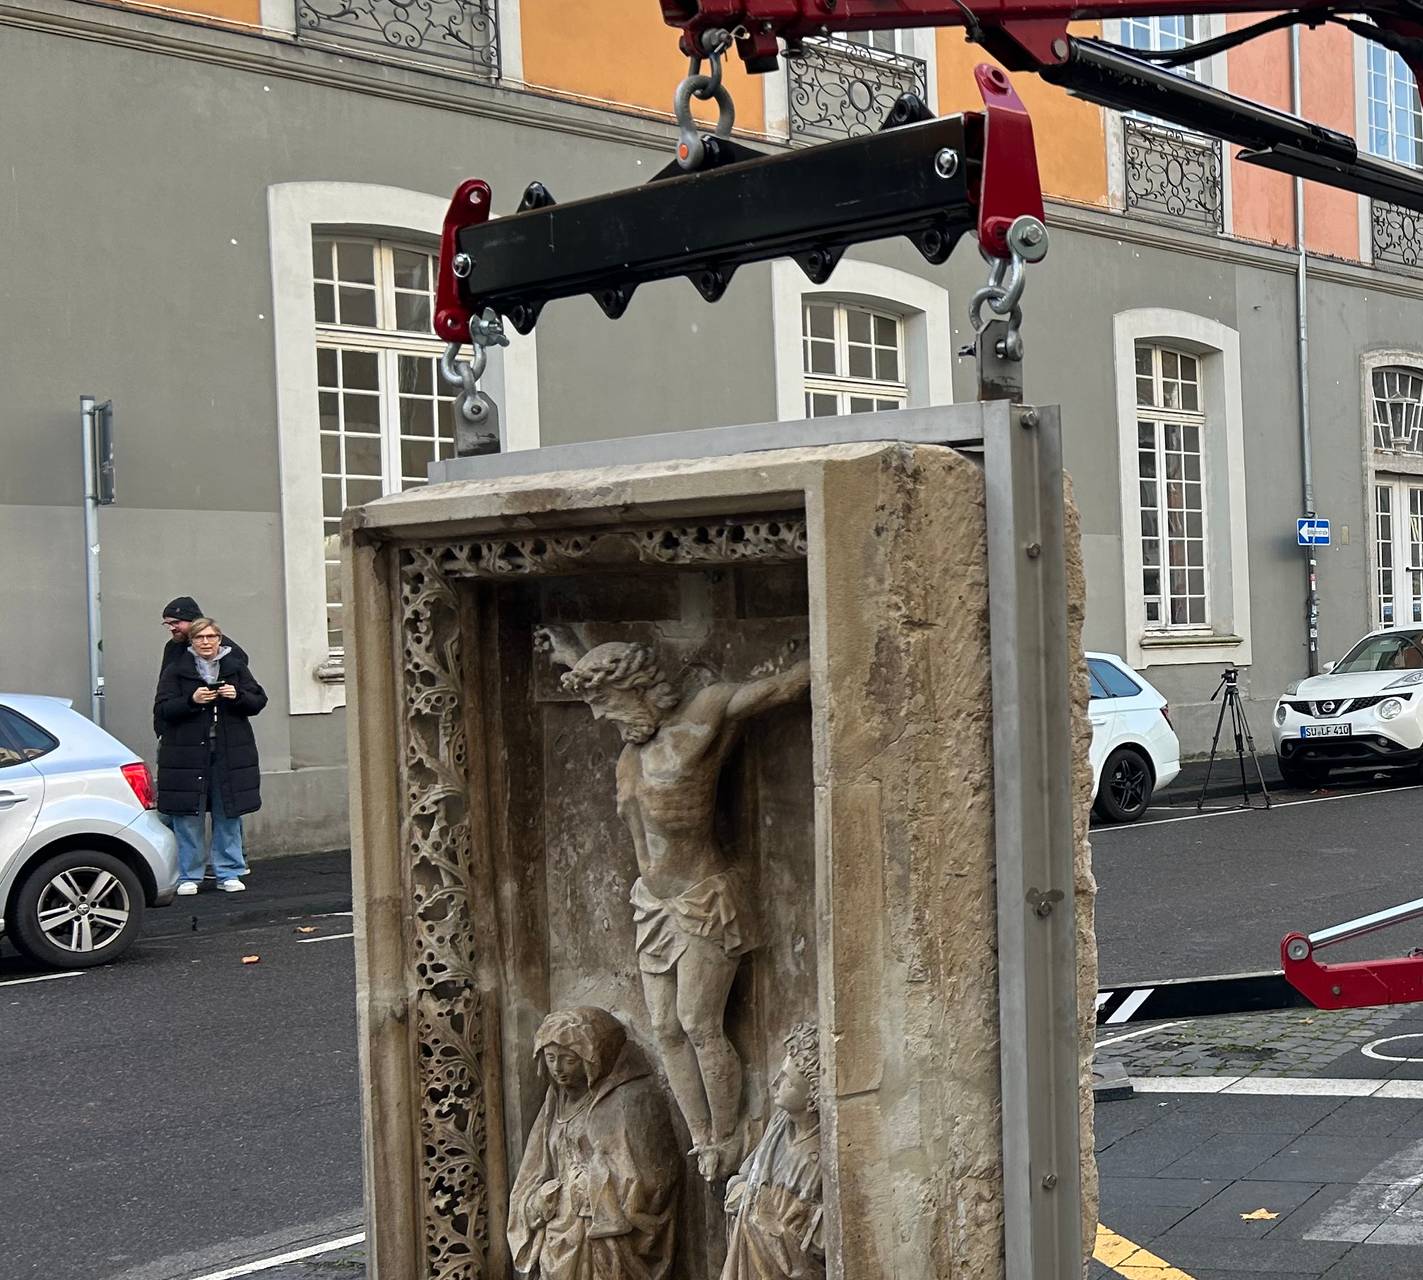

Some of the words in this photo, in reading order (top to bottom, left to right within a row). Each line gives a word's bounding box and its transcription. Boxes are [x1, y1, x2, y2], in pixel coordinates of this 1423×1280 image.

[1305, 727, 1317, 736] SU
[1321, 726, 1331, 735] LF
[1333, 725, 1349, 735] 410
